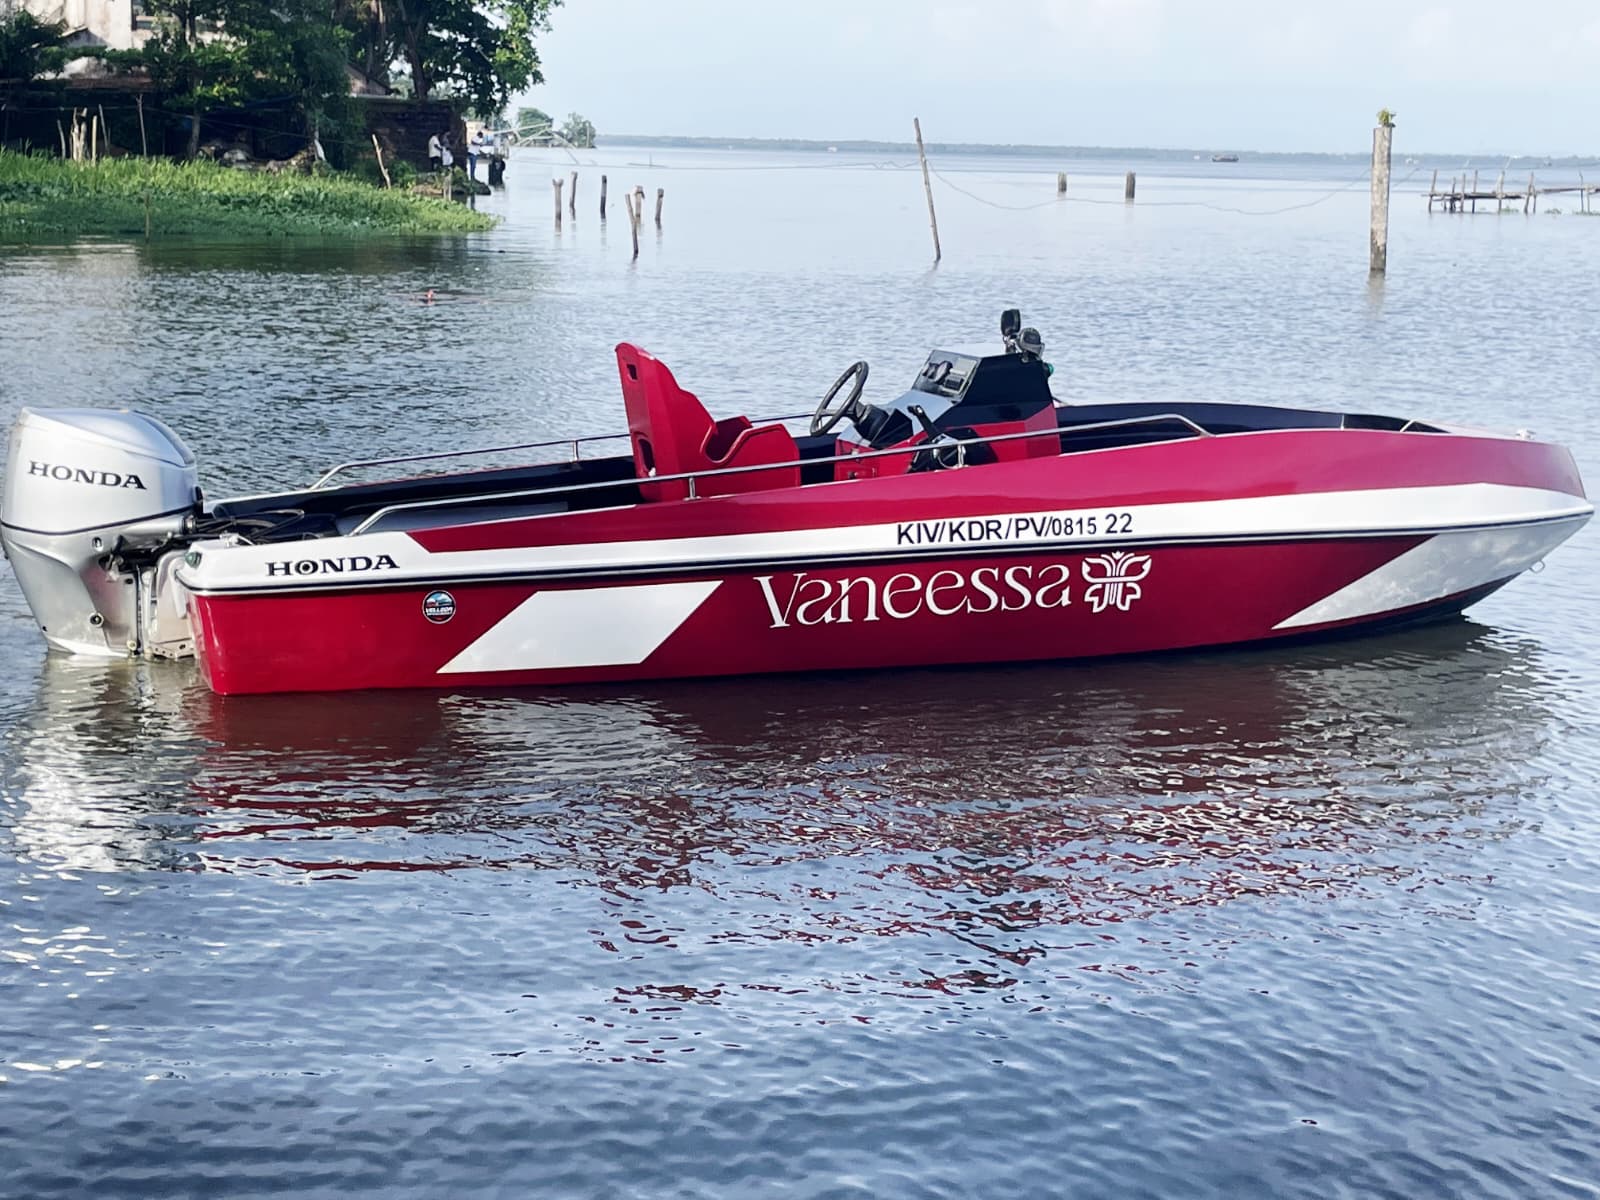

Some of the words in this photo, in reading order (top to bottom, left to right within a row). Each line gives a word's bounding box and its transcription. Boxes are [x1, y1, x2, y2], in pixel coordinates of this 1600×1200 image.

[28, 460, 147, 490] HONDA
[1105, 513, 1133, 534] 22
[267, 554, 400, 577] HONDA
[752, 564, 1071, 628] Vaneessa
